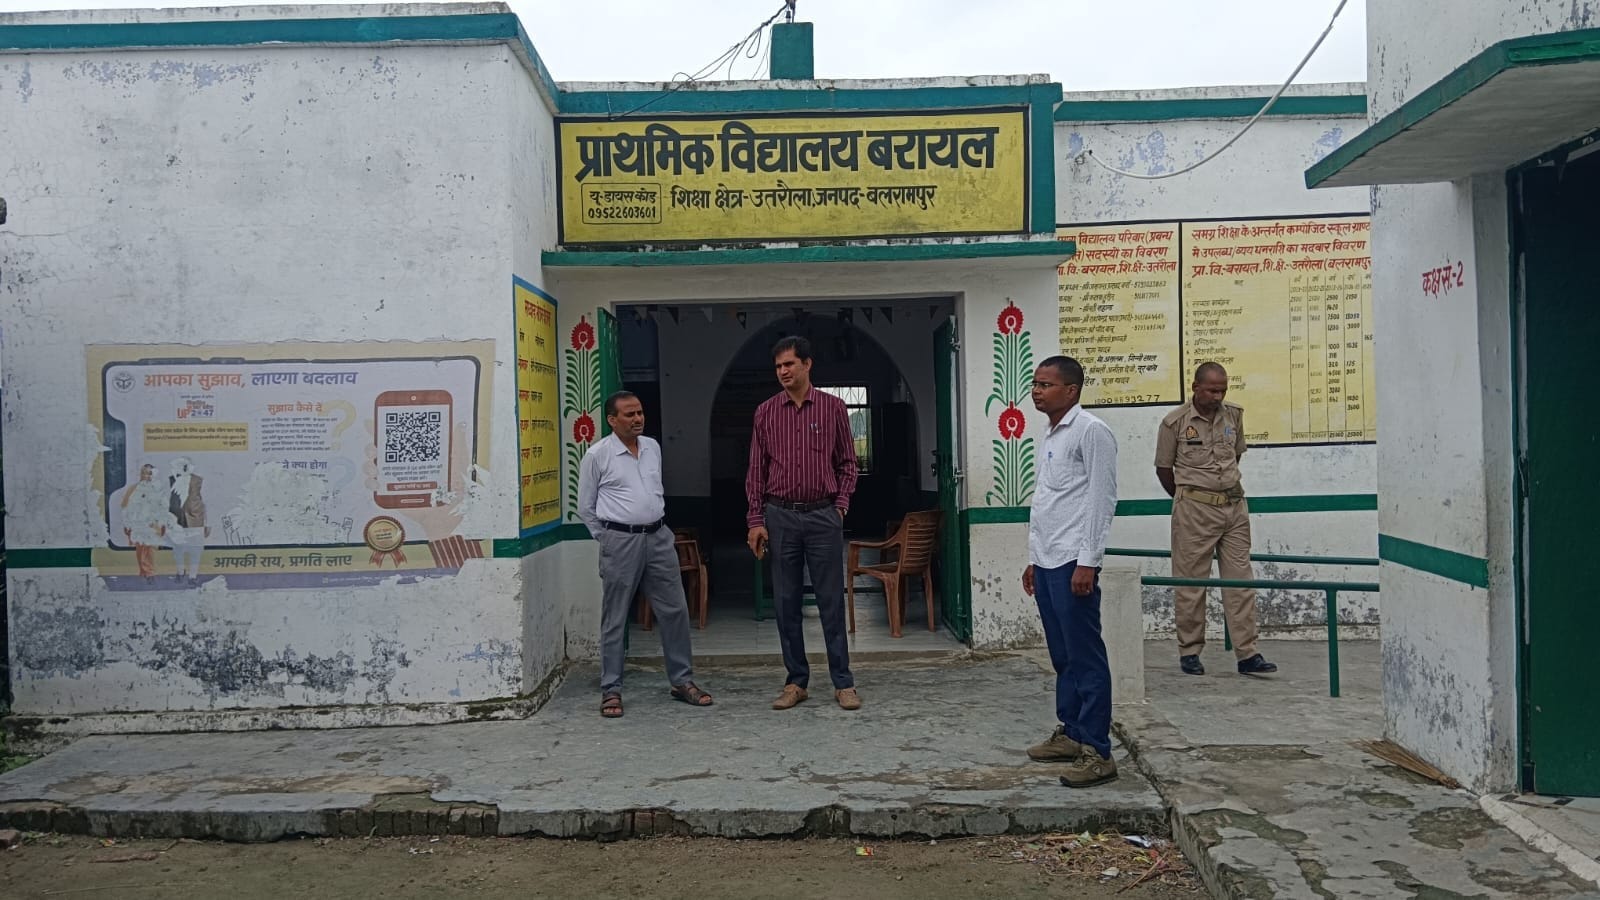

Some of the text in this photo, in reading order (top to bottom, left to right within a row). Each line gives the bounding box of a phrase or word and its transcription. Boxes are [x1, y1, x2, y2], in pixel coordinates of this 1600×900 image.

[575, 121, 999, 183] प्राथमिक विद्यालय बरायल
[670, 184, 711, 211] शिक्षा
[588, 205, 656, 219] 09522603601
[1079, 232, 1115, 245] विद्यालय
[1192, 229, 1216, 241] समग्र
[1217, 225, 1240, 240] शिक्षा
[1241, 224, 1250, 237] के
[1121, 249, 1135, 259] का
[1136, 245, 1169, 259] विवरण
[1286, 244, 1299, 254] का
[1332, 239, 1367, 252] विवरण
[144, 371, 359, 391] आपका सुझाव, लाएगा बदलाव
[268, 403, 294, 416] सुझाव
[213, 554, 257, 568] आपकी
[259, 556, 285, 569] राय,
[289, 552, 322, 567] प्रगति
